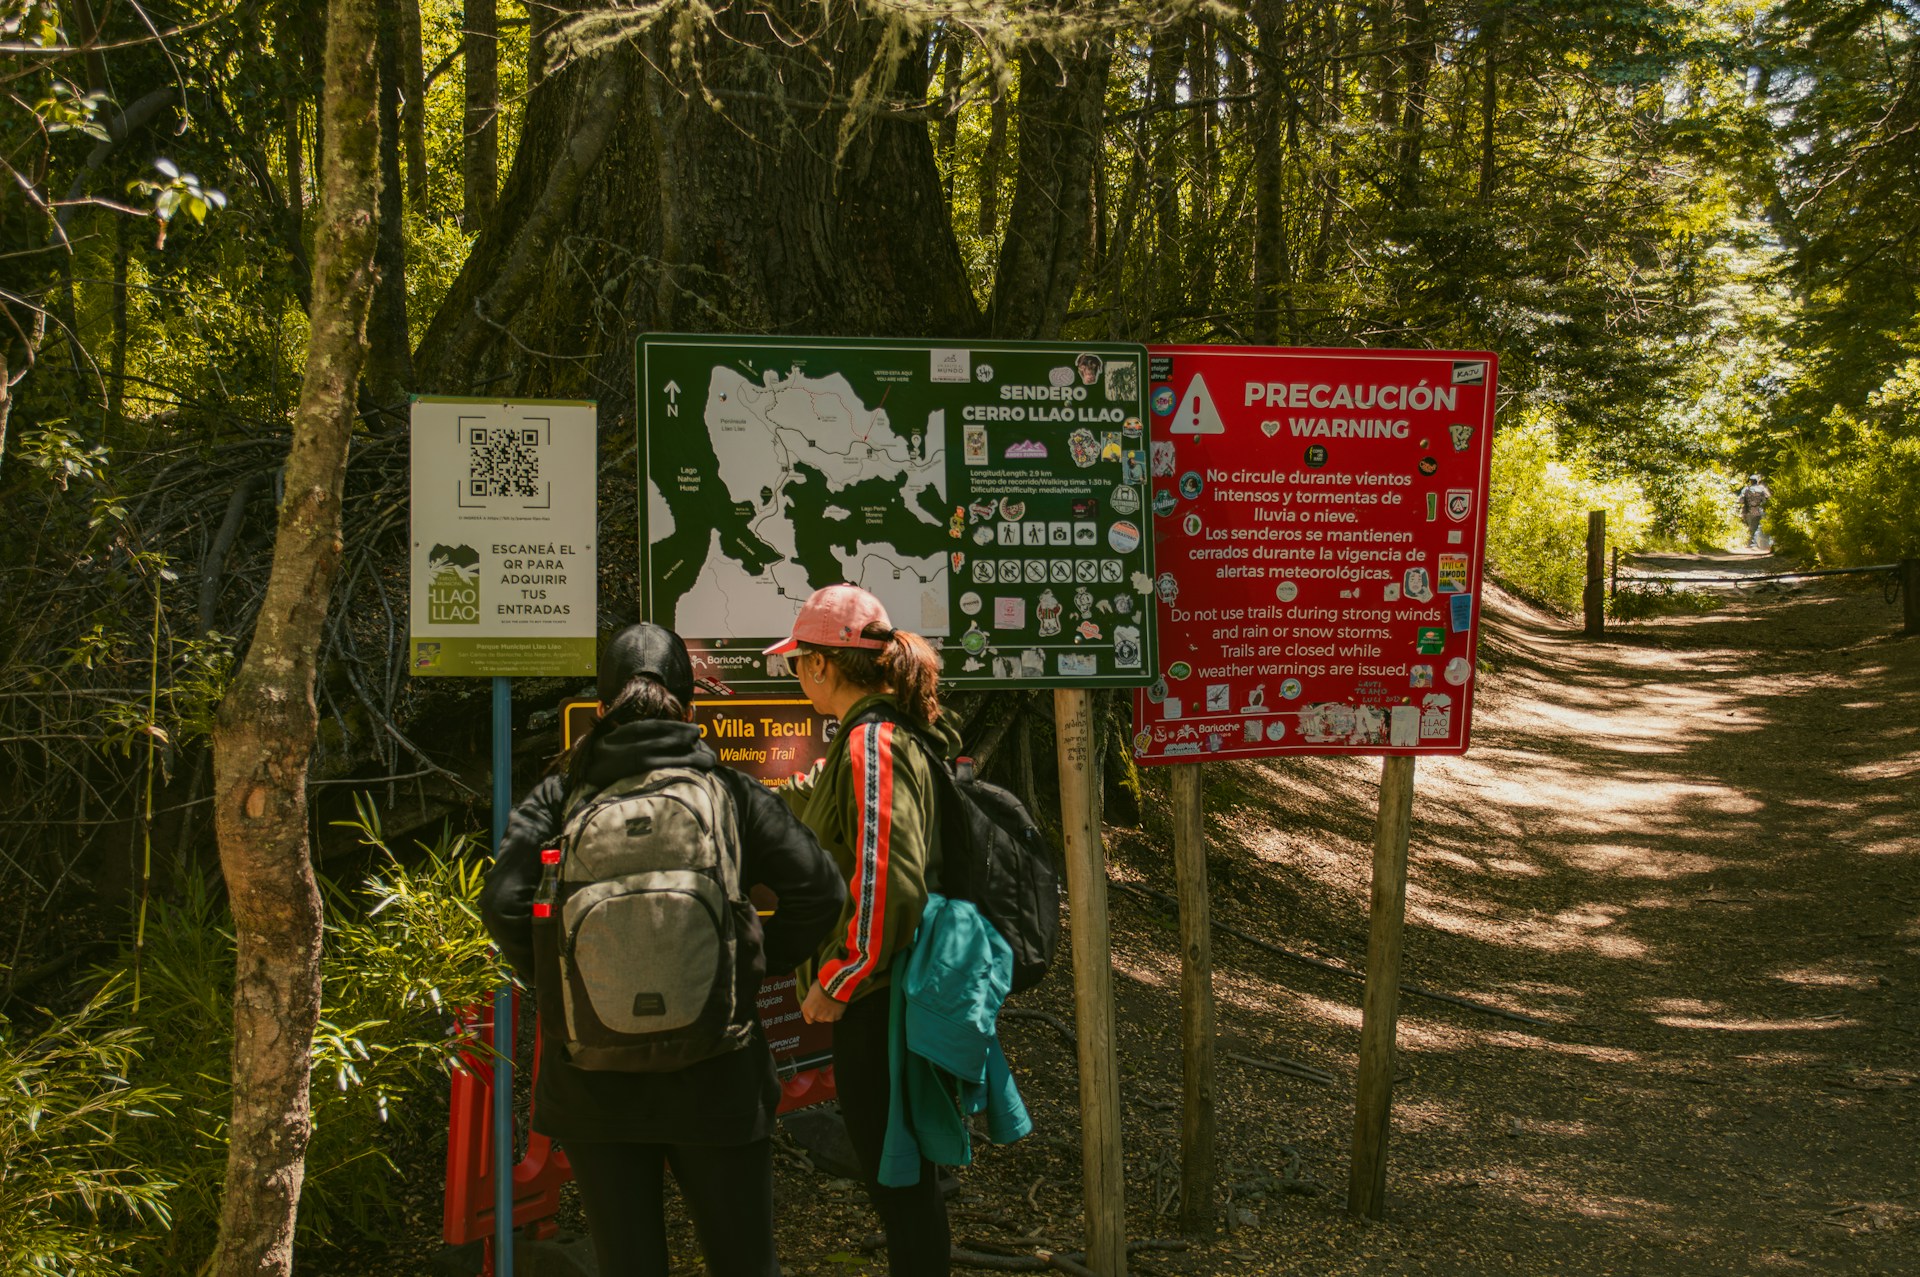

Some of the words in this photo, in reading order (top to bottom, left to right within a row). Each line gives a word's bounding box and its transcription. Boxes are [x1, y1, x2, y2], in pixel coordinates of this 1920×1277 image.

[999, 385, 1087, 401] SENDERO
[1244, 379, 1457, 411] PRECAUCIÓN
[667, 404, 679, 418] N
[962, 406, 1026, 421] CERRO
[1028, 407, 1075, 422] LLAO
[1078, 407, 1125, 423] LLAO
[1288, 417, 1410, 439] WARNING
[680, 467, 698, 475] Lago
[970, 470, 1028, 479] Longitud/Length:
[1206, 469, 1228, 483] No
[1231, 469, 1285, 484] circule
[1289, 470, 1352, 485] durante
[1355, 471, 1412, 487] vientos
[970, 478, 997, 486] Tiempo
[1008, 478, 1067, 488] recorrido/Walking
[970, 486, 1038, 495] Dificultad/Difficulty:
[1039, 487, 1091, 495] media/medium
[1214, 487, 1280, 503] intensos
[1282, 492, 1293, 506] y
[1296, 490, 1378, 505] tormentas
[1381, 491, 1402, 506] de
[1253, 507, 1296, 522] lluvia
[1299, 510, 1310, 522] o
[1313, 508, 1359, 523] nieve.
[1205, 527, 1228, 541] Los
[1230, 527, 1302, 542] senderos
[1305, 530, 1322, 542] se
[1326, 529, 1413, 543] mantienen
[492, 542, 556, 555] ESCANEÁ
[560, 545, 576, 555] EL
[1188, 545, 1249, 560] cerrados
[1252, 546, 1315, 561] durante
[1319, 547, 1333, 561] la
[1337, 547, 1401, 564] vigencia
[1405, 548, 1426, 562] de
[503, 559, 523, 570] QR
[528, 559, 564, 570] PARA
[501, 574, 568, 585] ADQUIRIR
[1216, 564, 1265, 579] alertas
[1268, 566, 1393, 583] meteorológicas.
[433, 589, 477, 604] LLAO
[521, 589, 547, 600] TUS
[433, 605, 477, 621] LLAO
[497, 604, 571, 615] ENTRADAS
[1171, 609, 1190, 622] Do
[1194, 608, 1217, 621] not
[1220, 608, 1244, 621] use
[1247, 606, 1282, 620] trails
[1286, 606, 1338, 622] during
[1342, 608, 1391, 623] strong
[1394, 608, 1441, 621] winds
[1212, 625, 1239, 640] and
[1242, 624, 1268, 639] rain
[1272, 627, 1288, 639] or
[1292, 627, 1334, 639] snow
[1336, 627, 1392, 640] storms.
[500, 643, 531, 651] Municipal
[1220, 644, 1255, 658] Trails
[1257, 646, 1281, 657] are
[1284, 643, 1335, 657] closed
[1338, 644, 1381, 658] while
[707, 655, 752, 665] Bariloche
[1197, 663, 1254, 678] weather
[1256, 662, 1326, 678] warnings
[1329, 665, 1354, 677] are
[1358, 663, 1409, 677] issued.
[712, 718, 755, 738] Villa
[760, 718, 812, 738] Tacul
[1198, 723, 1241, 734] Bariloche
[1424, 718, 1448, 727] LLAO
[1423, 727, 1447, 736] LLAO
[719, 749, 767, 763] Walking
[770, 747, 796, 761] Trail
